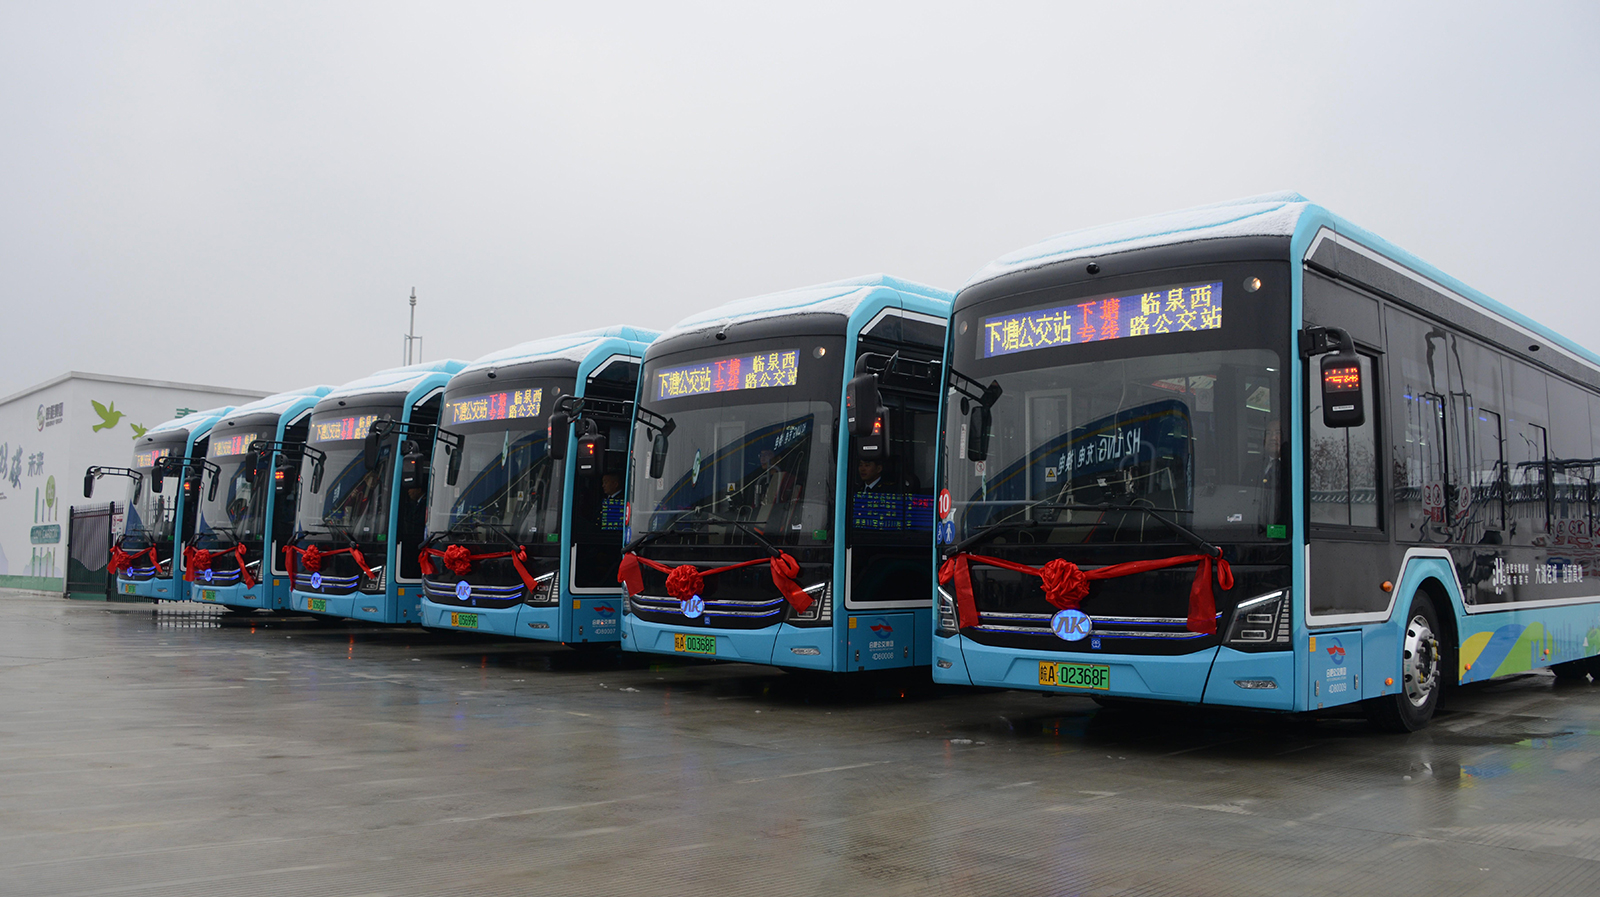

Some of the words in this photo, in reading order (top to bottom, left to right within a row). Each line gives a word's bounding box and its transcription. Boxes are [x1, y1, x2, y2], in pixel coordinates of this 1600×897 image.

[1076, 298, 1120, 322] 下塘
[1140, 284, 1212, 316] 临泉西
[984, 310, 1072, 353] 下塘公交站
[1129, 304, 1222, 338] 路公交站
[714, 358, 741, 376] 下塘
[752, 351, 796, 374] 临泉西
[658, 366, 712, 398] 下塘公交站
[452, 399, 488, 423] 下塘公交站
[938, 493, 950, 514] 10
[687, 636, 715, 652] 00368F
[1060, 666, 1108, 687] 02368F
